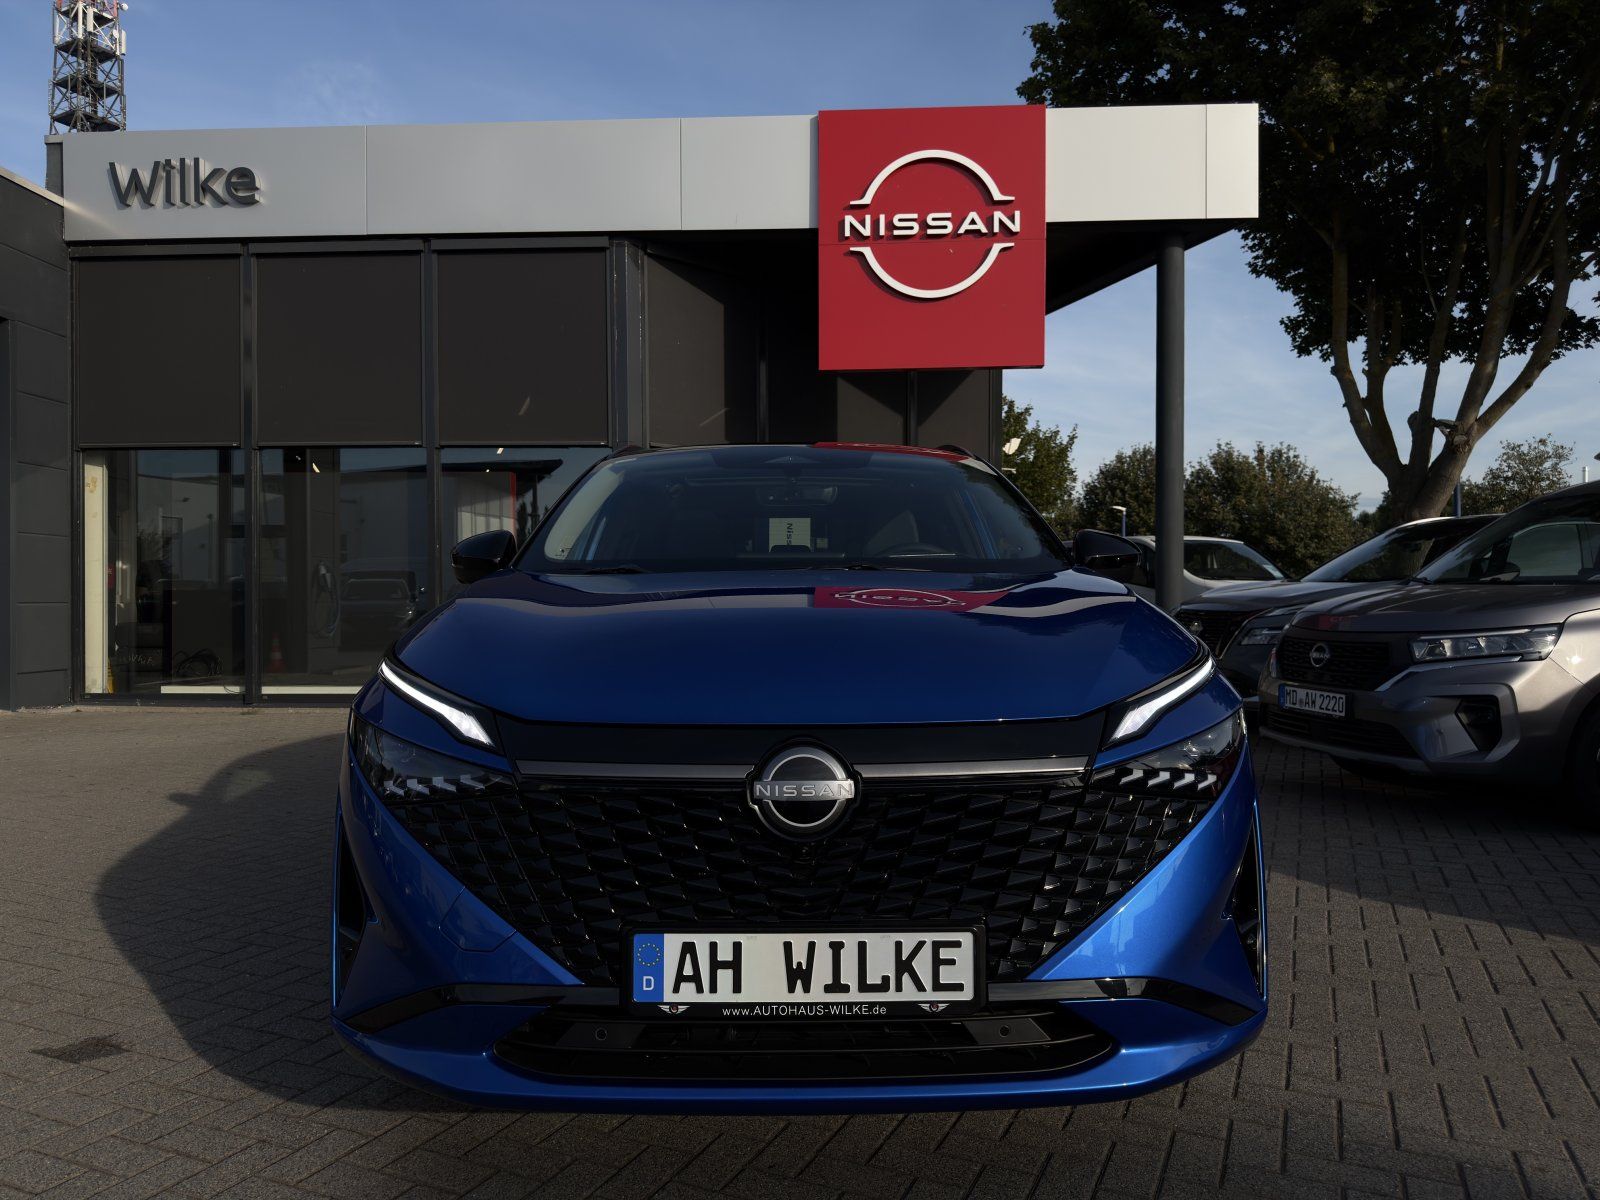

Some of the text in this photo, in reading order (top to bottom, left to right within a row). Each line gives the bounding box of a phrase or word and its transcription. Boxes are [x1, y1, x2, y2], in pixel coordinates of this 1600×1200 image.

[108, 156, 260, 208] Wilke
[844, 210, 1021, 237] NISSAN
[1285, 689, 1344, 713] MD AW 2220
[756, 783, 853, 797] NISSAN
[672, 940, 965, 994] AH WILKE
[642, 975, 655, 991] D
[722, 1004, 887, 1016] www.AUTOHAUS-WILKE.de
